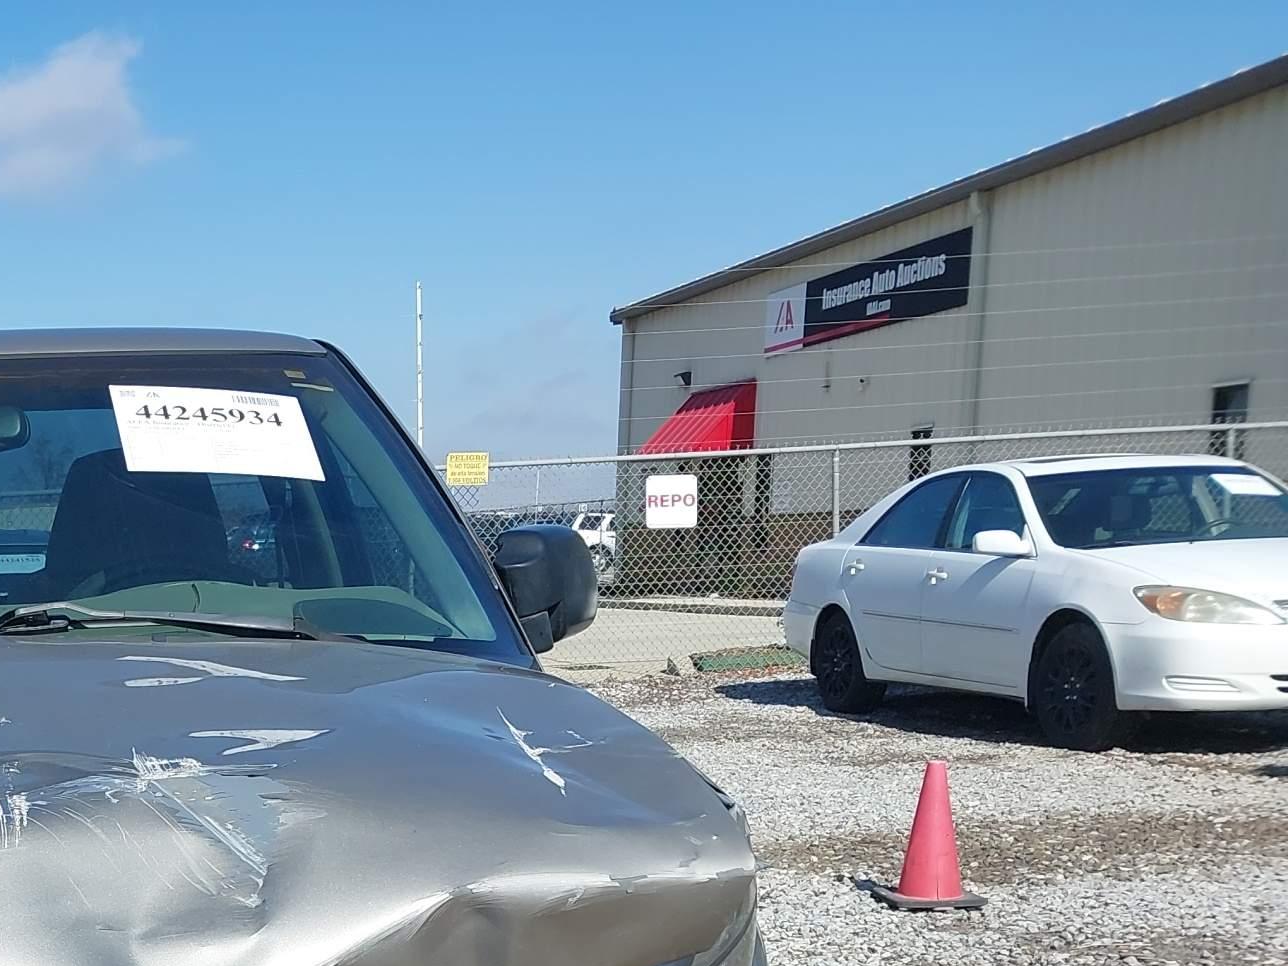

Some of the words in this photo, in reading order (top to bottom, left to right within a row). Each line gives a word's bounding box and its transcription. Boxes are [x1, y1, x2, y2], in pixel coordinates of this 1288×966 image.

[822, 276, 871, 310] Insurance
[871, 269, 896, 294] Auto
[896, 254, 946, 288] Auctions
[135, 404, 283, 427] 44245934
[647, 493, 696, 508] REPO
